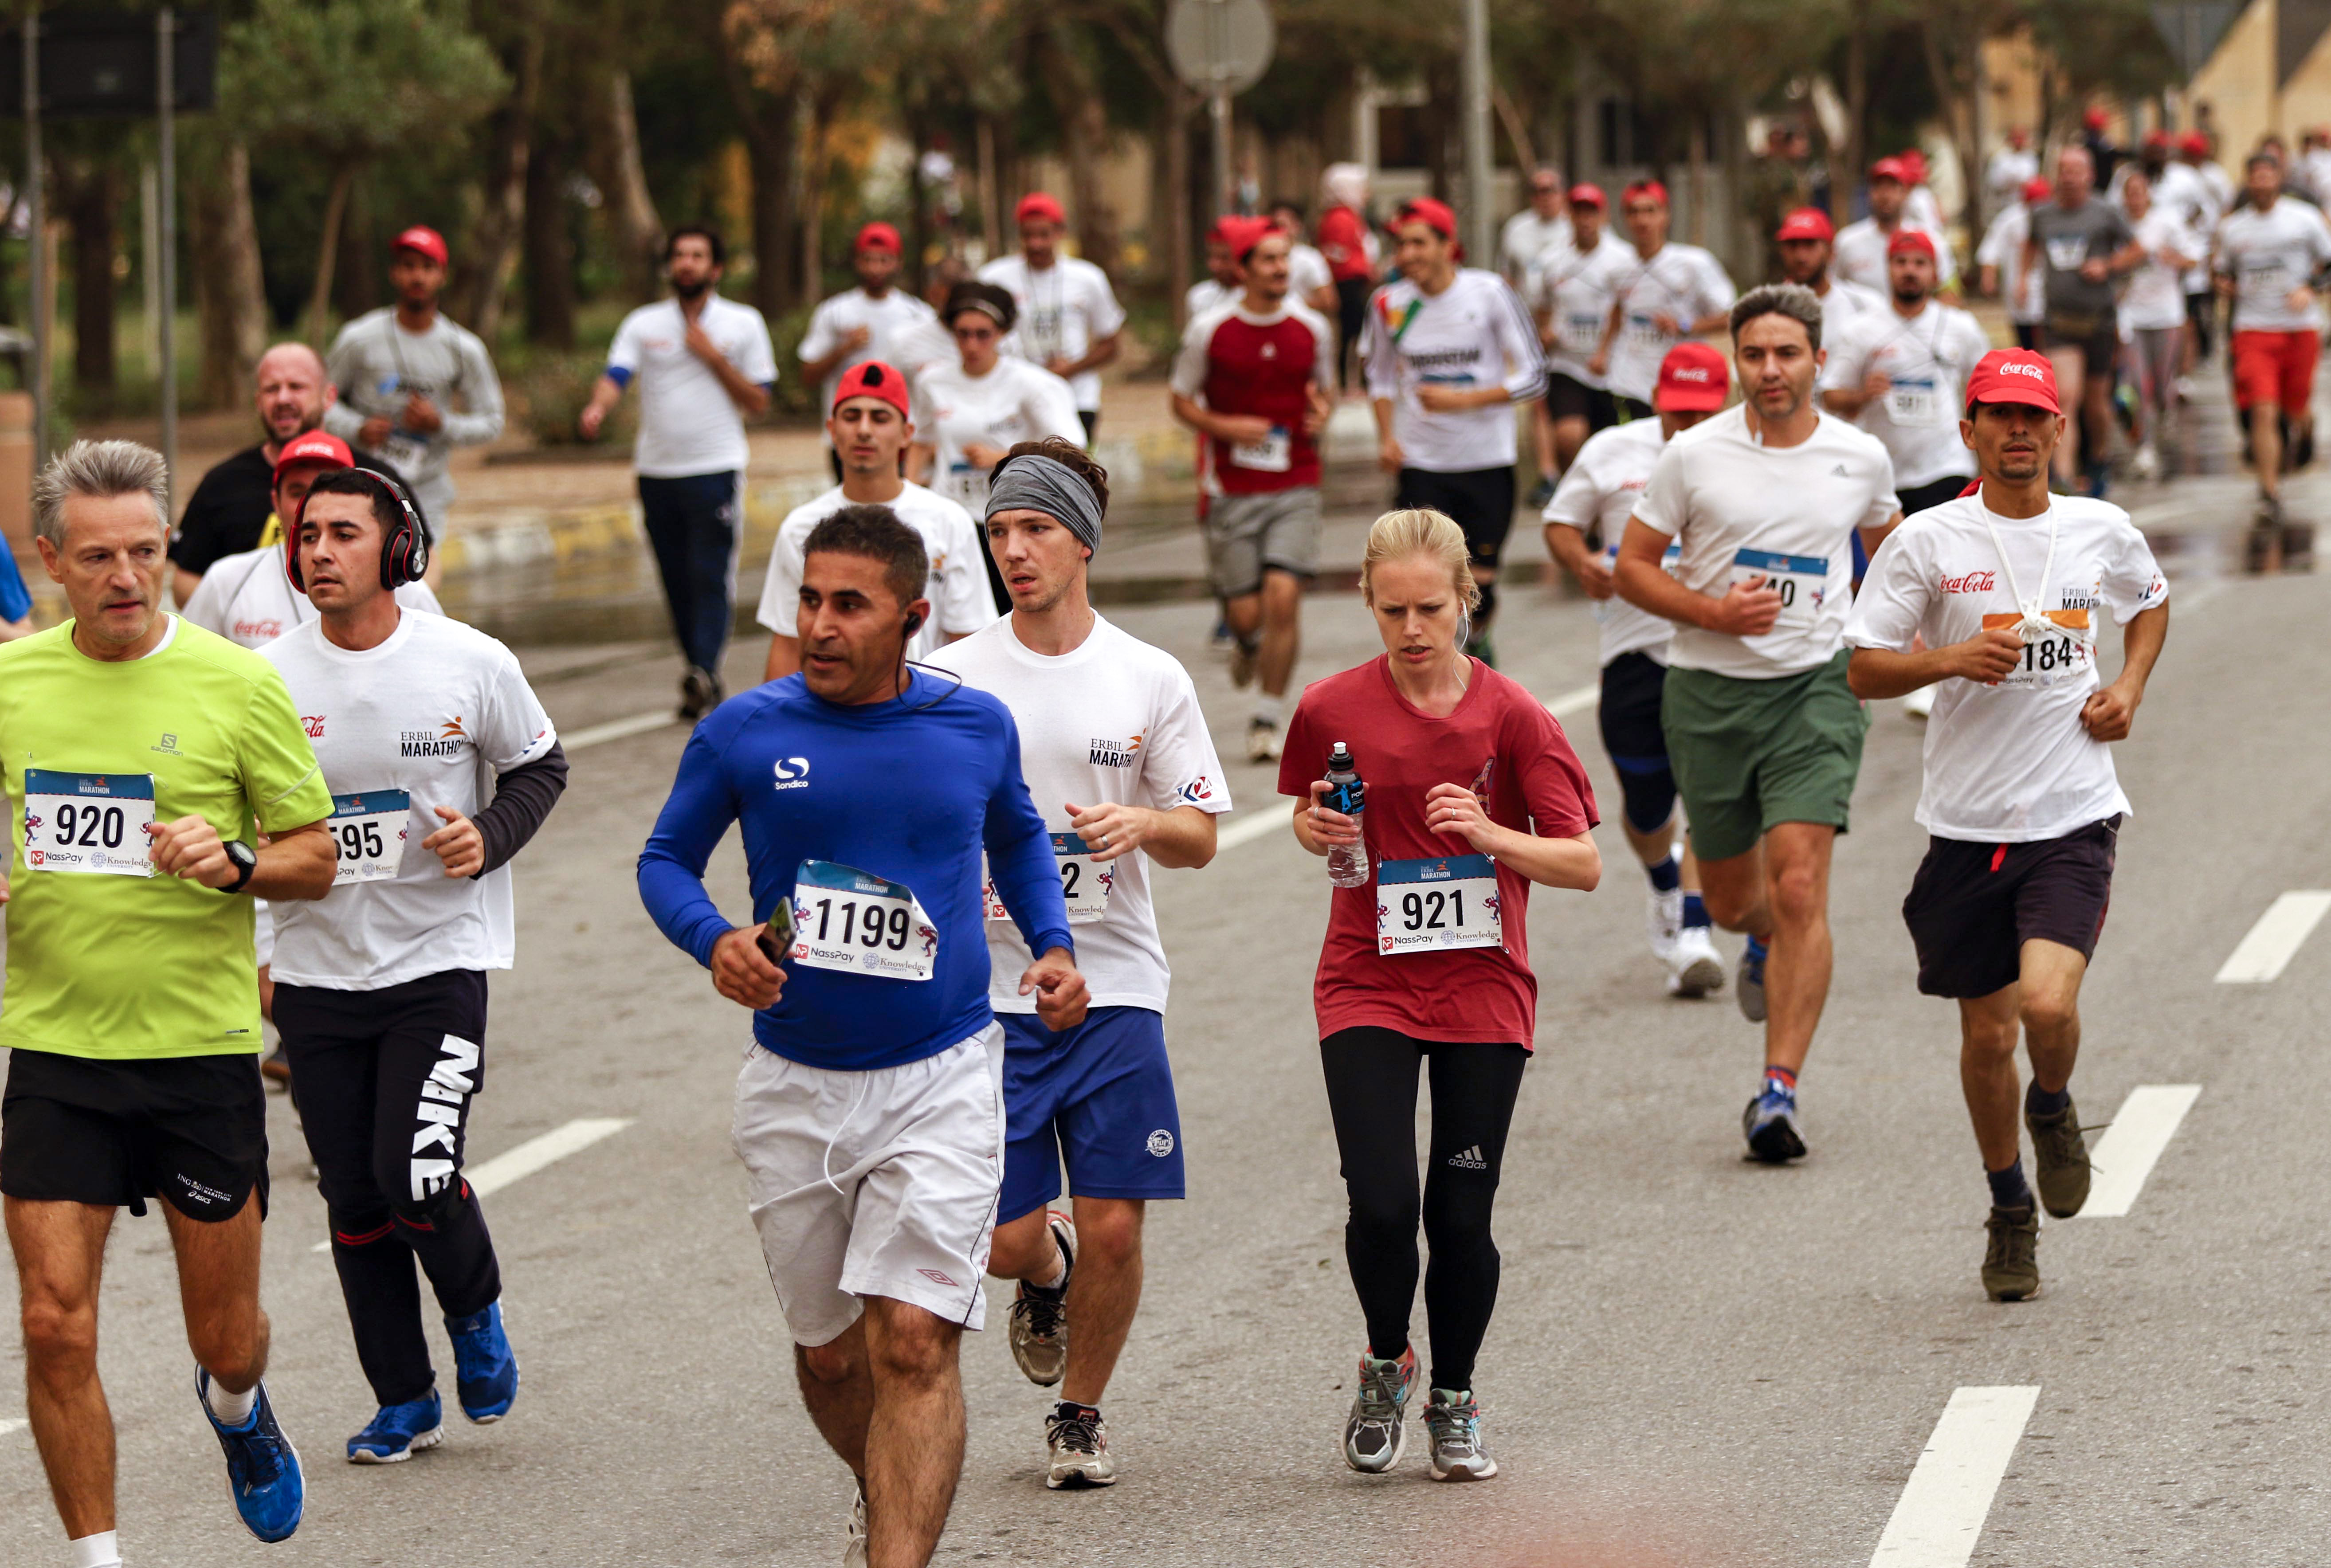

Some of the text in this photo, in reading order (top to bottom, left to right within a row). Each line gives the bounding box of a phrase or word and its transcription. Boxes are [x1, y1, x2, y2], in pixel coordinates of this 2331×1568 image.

[1999, 361, 2044, 382] Coca-Cola
[2062, 588, 2089, 597] ERBIL
[401, 732, 436, 741] ERBIL
[401, 739, 467, 757] MARATHO
[1091, 738, 1123, 751] ERBIL
[79, 786, 110, 795] MARATHON
[775, 780, 808, 790] Sondico
[338, 805, 366, 815] MARATHON
[56, 804, 124, 848] 920
[46, 852, 83, 864] NassPay
[107, 856, 152, 868] Knowledge
[855, 882, 889, 893] MARATHON
[1402, 889, 1464, 931] 921
[816, 898, 910, 951] 1199
[1395, 935, 1433, 945] NassPay
[1456, 930, 1499, 940] Knowledge
[811, 947, 855, 963] NassPay
[880, 957, 926, 971] Knowledge
[411, 1033, 480, 1201] NIKE
[1448, 1157, 1487, 1169] adidas
[177, 1173, 192, 1186] ING
[195, 1194, 212, 1204] asics
[204, 1190, 231, 1202] MARATHON
